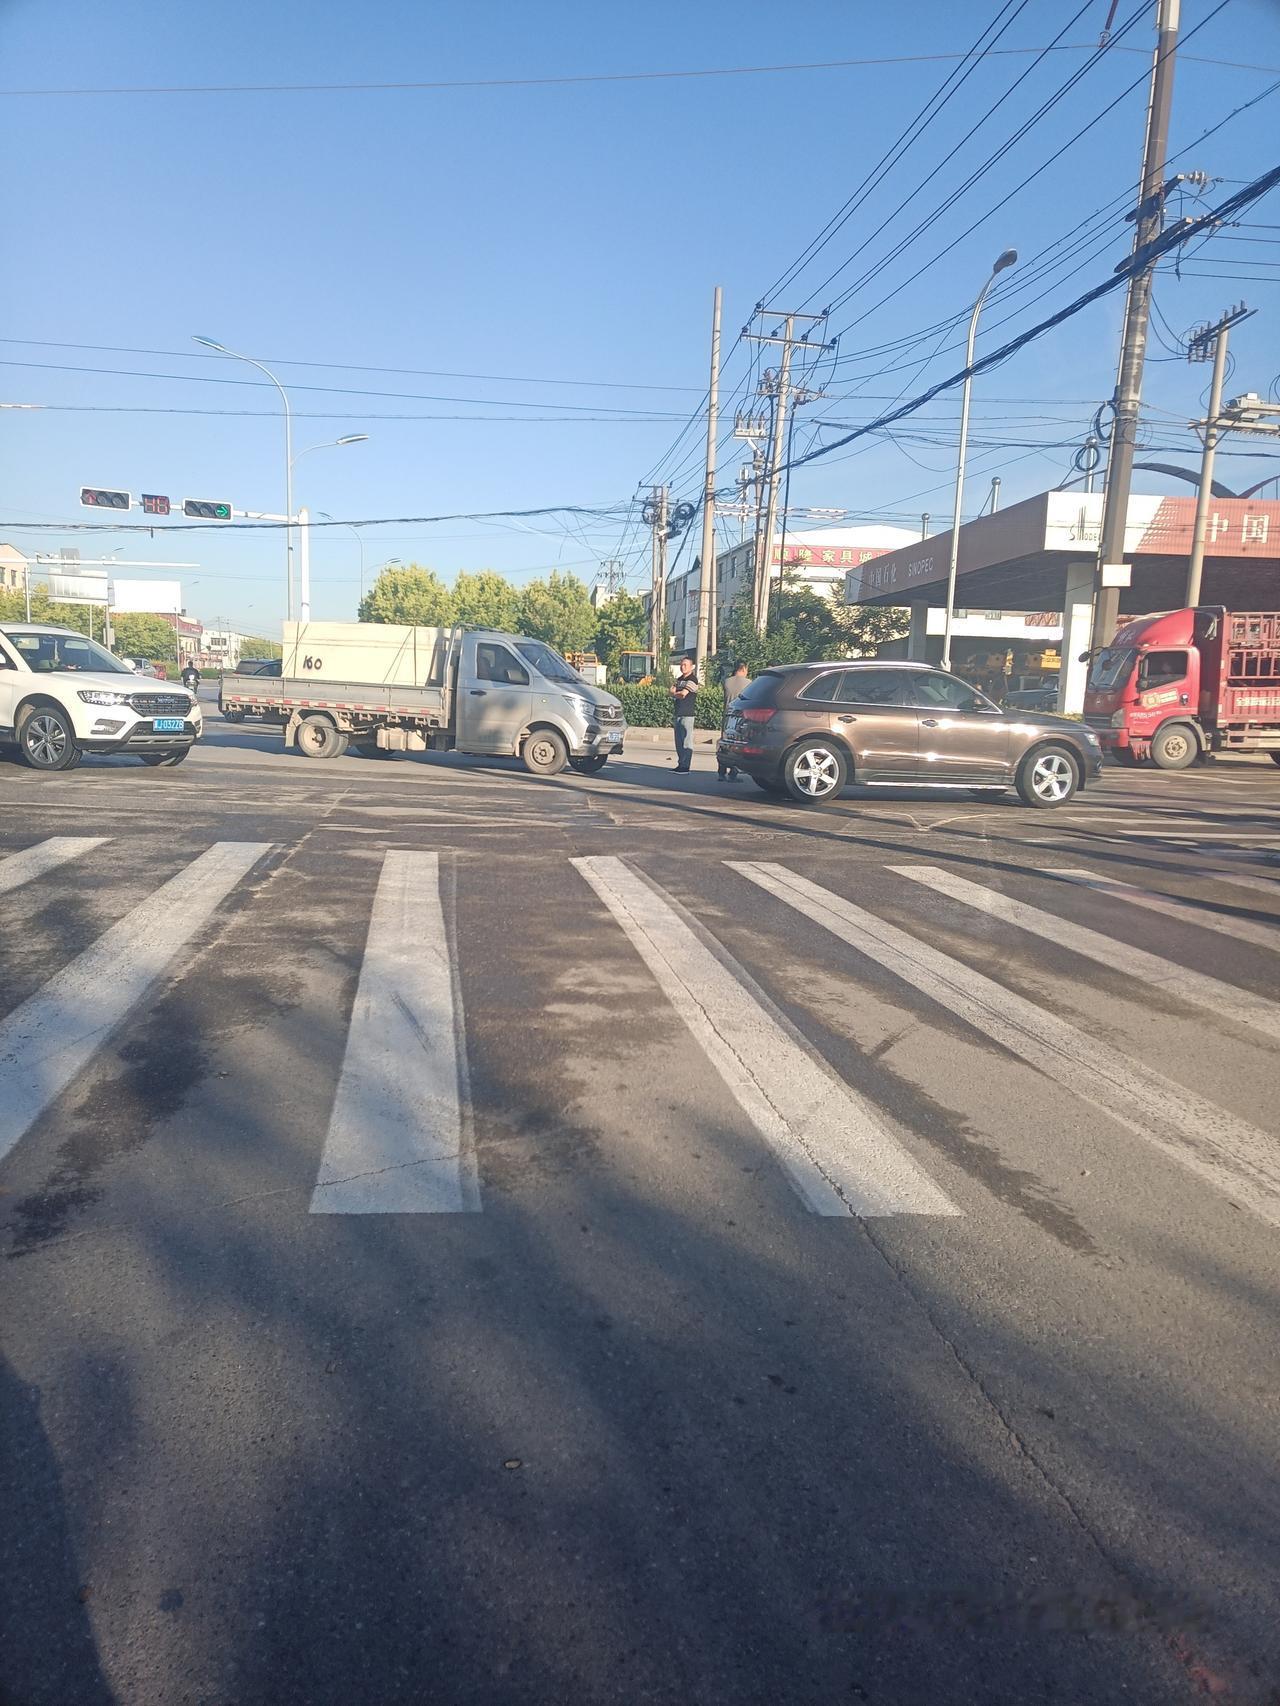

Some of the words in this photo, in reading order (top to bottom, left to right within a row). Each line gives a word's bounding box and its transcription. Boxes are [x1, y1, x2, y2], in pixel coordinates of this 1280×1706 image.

[773, 547, 886, 563] 顺隆家具城
[908, 557, 934, 577] SINOPEC
[303, 655, 322, 670] 160
